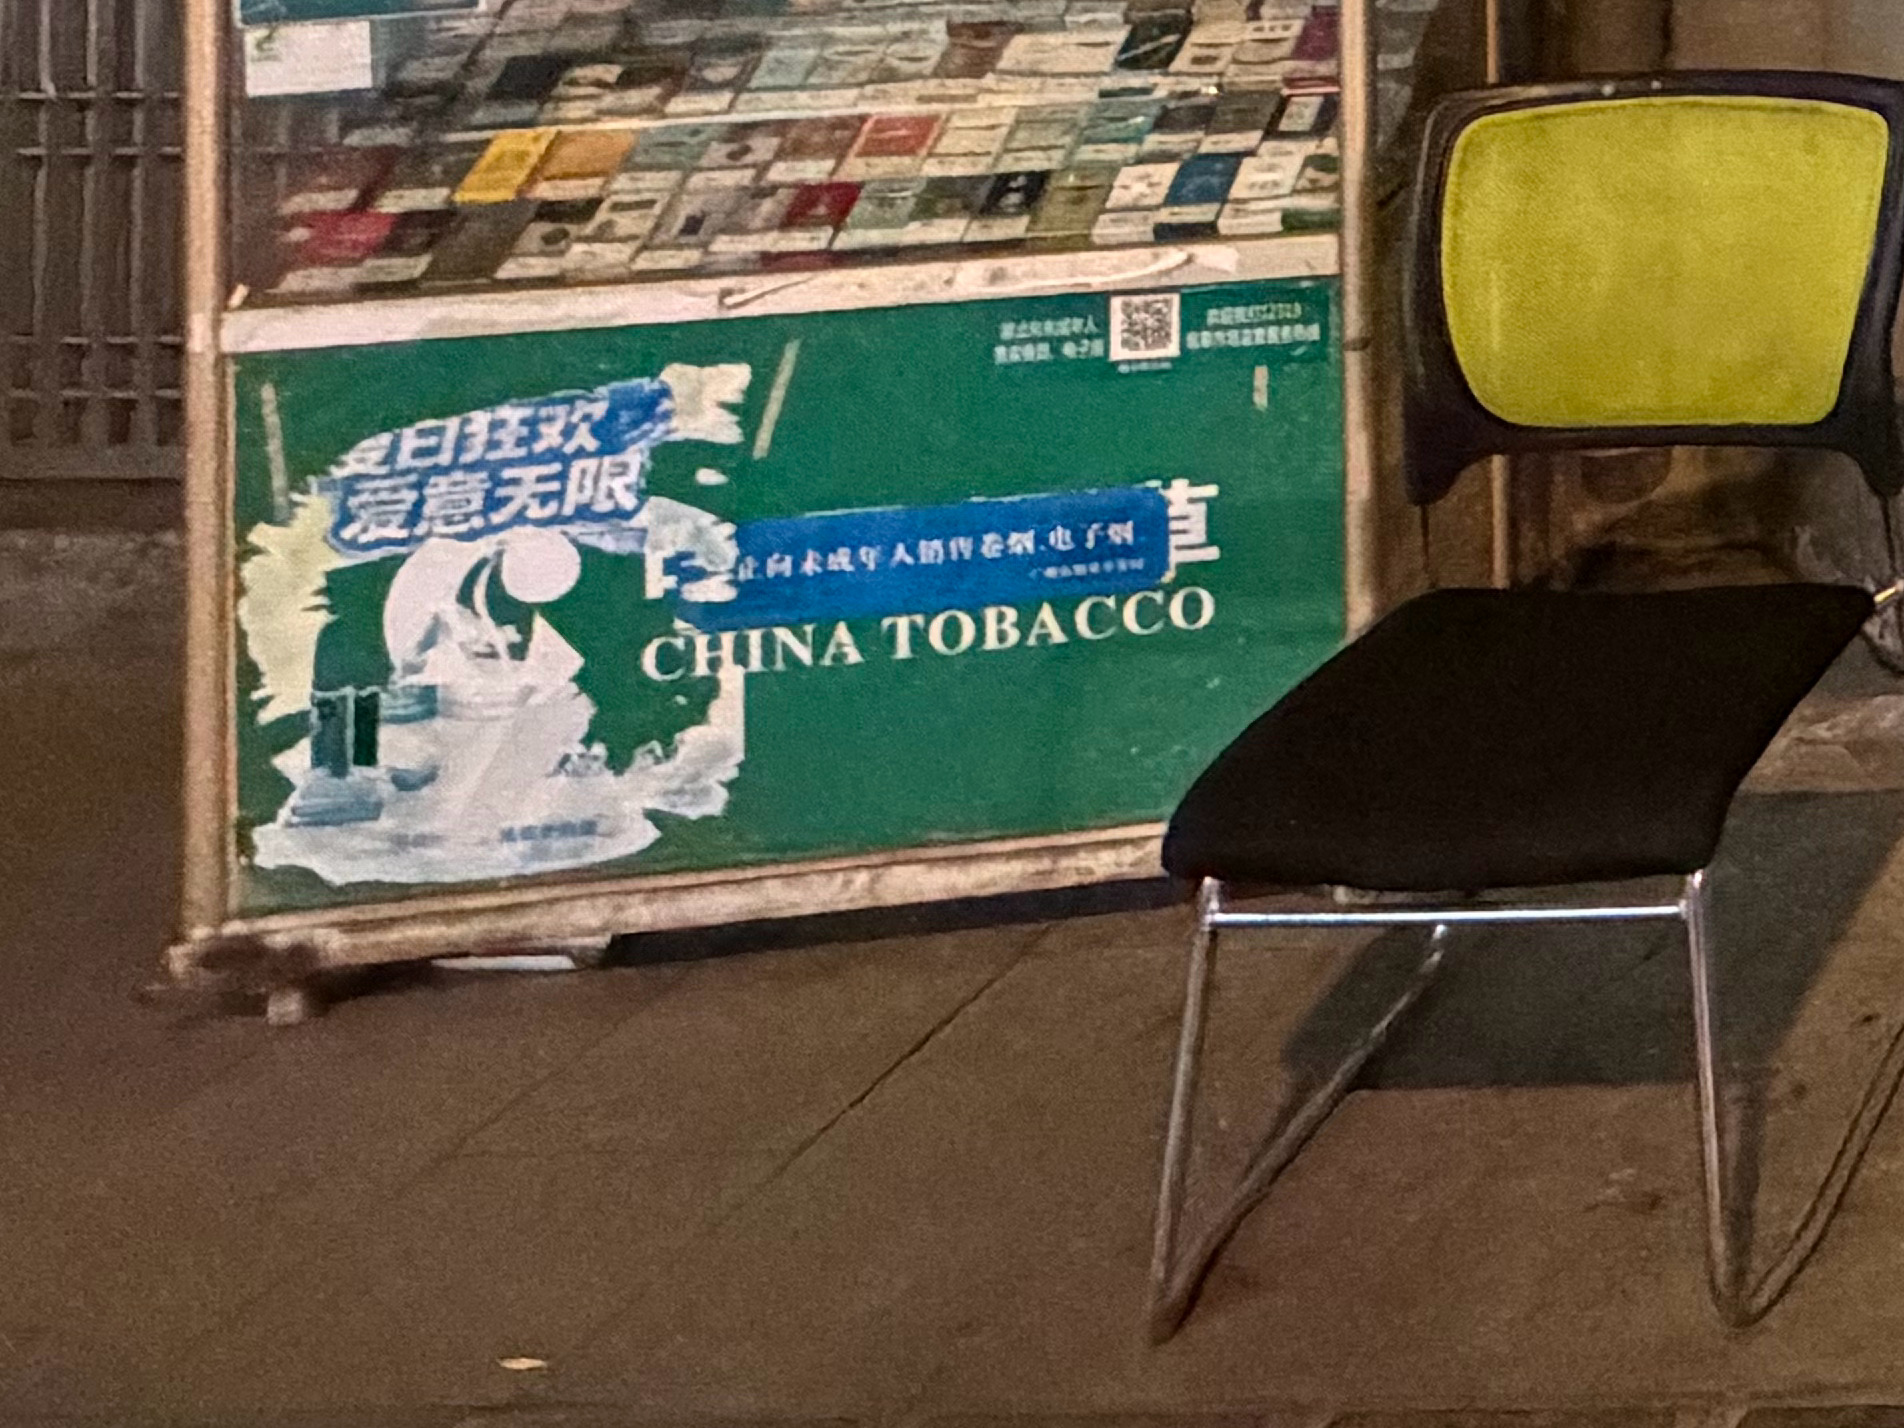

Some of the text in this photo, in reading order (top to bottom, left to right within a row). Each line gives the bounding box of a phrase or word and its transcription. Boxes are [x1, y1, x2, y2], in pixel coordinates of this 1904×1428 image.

[333, 398, 612, 478] 夏日狂欢
[340, 448, 645, 542] 爱意无限
[640, 585, 1218, 684] CHINA TOBACCO
